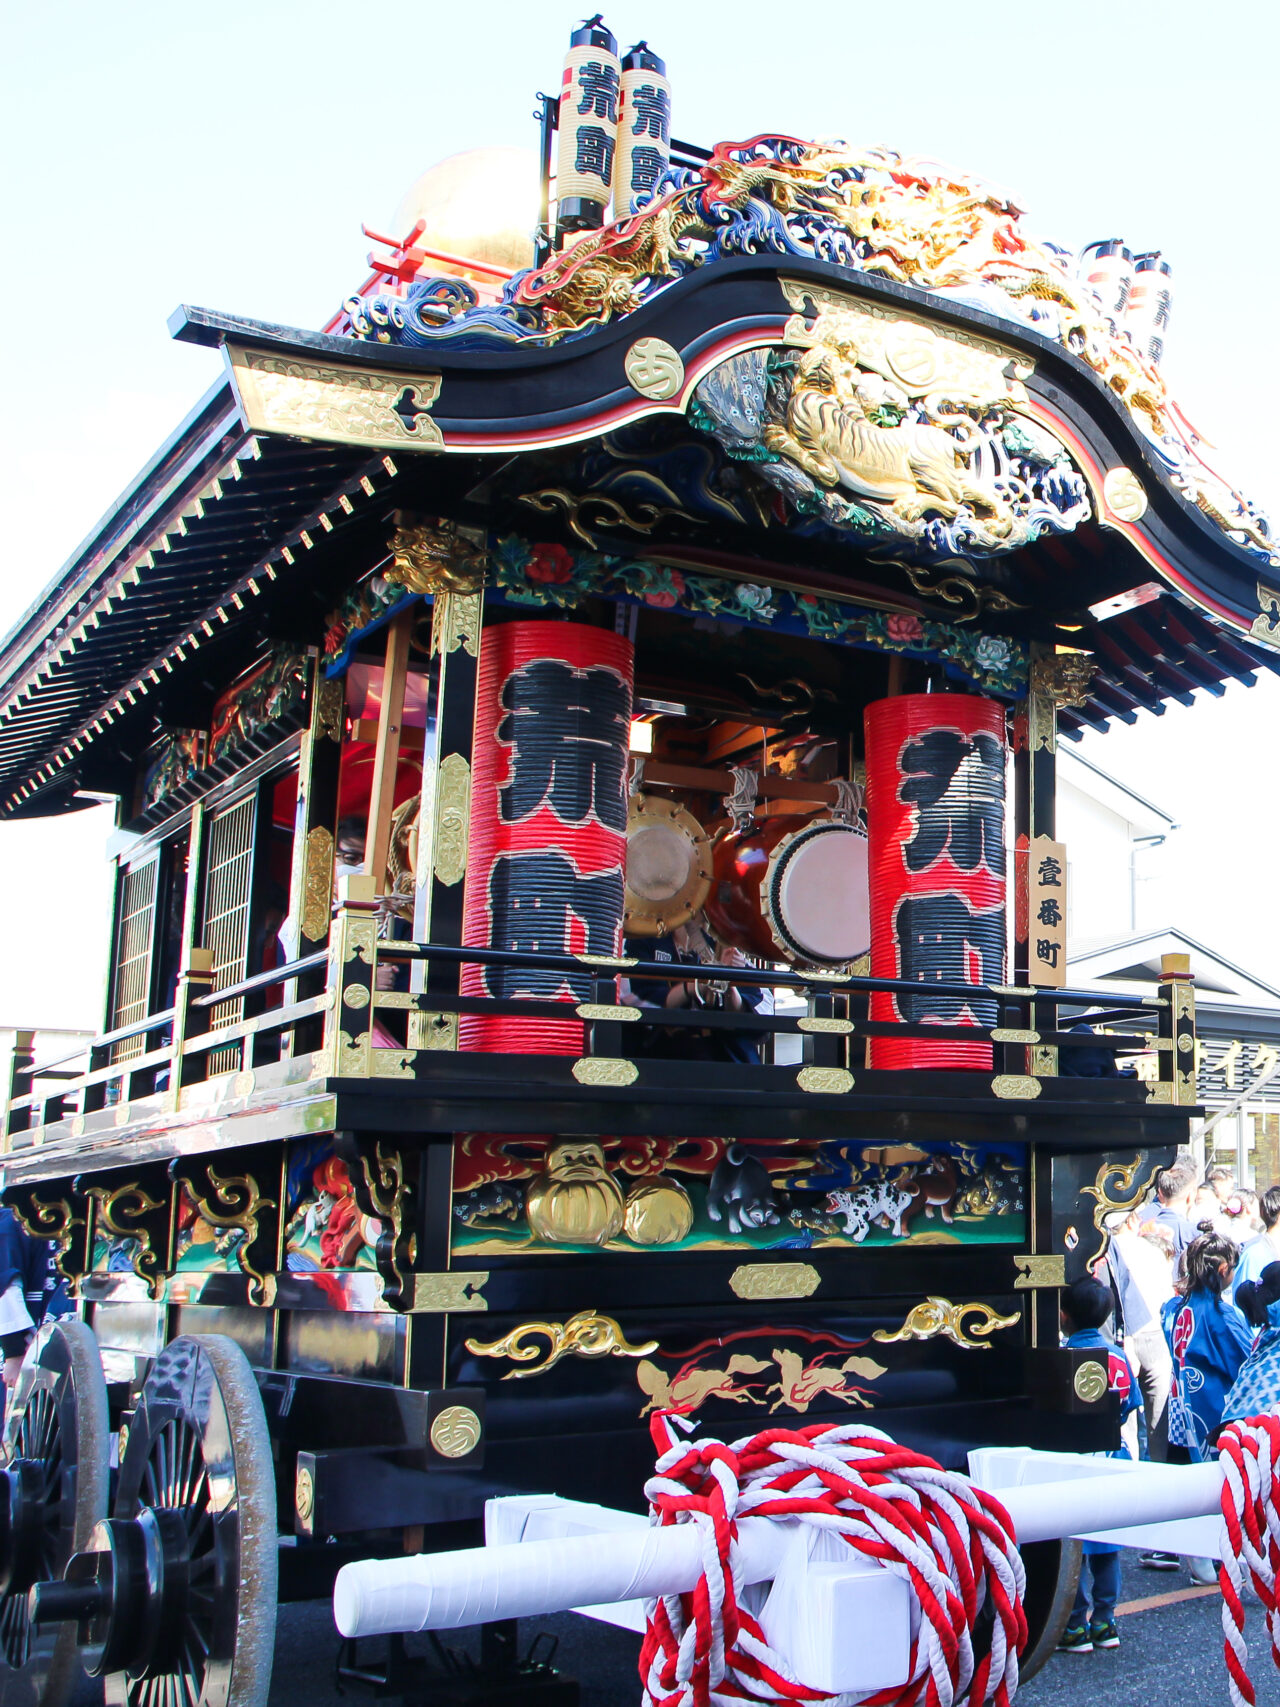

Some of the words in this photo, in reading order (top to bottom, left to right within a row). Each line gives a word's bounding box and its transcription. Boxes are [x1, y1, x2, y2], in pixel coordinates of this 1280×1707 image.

[575, 61, 620, 187] 荒町
[482, 659, 628, 1000] 荒町
[891, 727, 1006, 1027] 荒町
[1037, 856, 1062, 969] 壹番町
